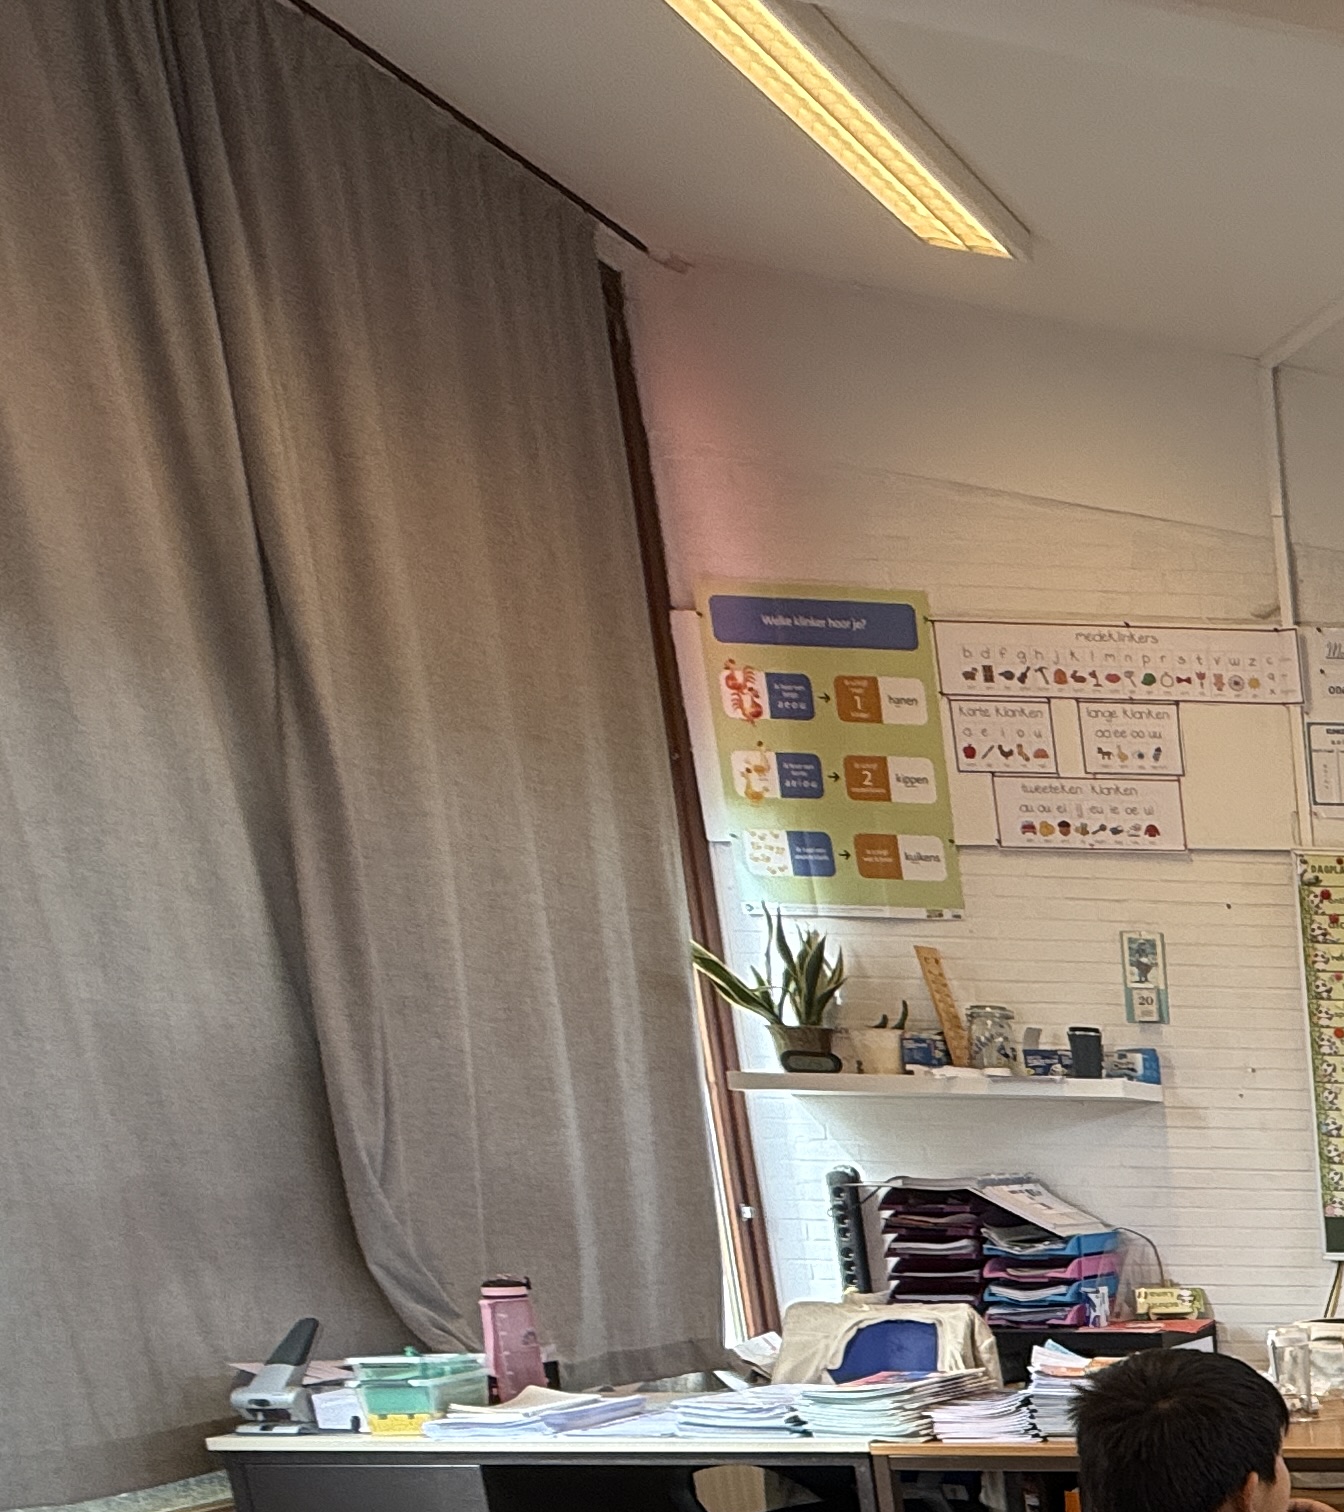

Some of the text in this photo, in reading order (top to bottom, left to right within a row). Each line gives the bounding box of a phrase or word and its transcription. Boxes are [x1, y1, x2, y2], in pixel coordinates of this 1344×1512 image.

[761, 614, 867, 631] Welke klinker hoor je?
[862, 771, 873, 786] 2
[895, 773, 929, 788] kippen
[904, 852, 941, 864] kuikens
[1138, 995, 1154, 1006] 20
